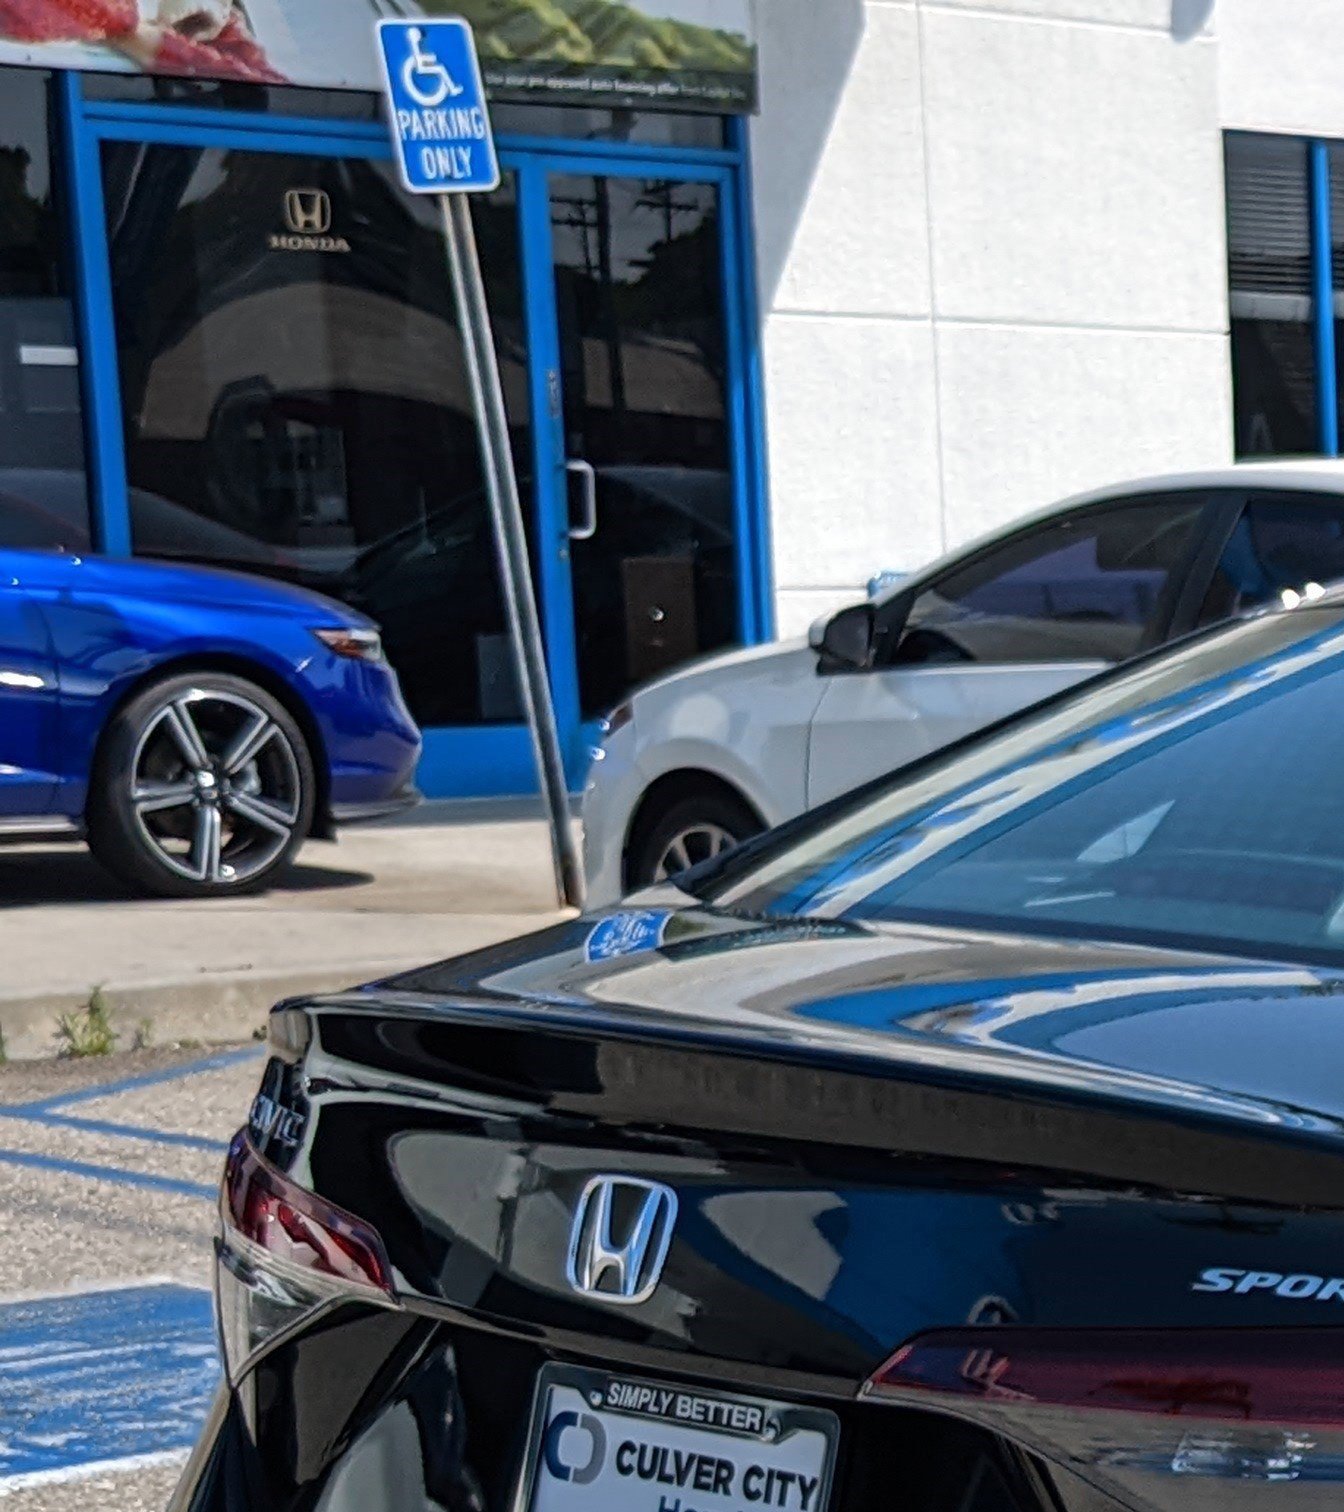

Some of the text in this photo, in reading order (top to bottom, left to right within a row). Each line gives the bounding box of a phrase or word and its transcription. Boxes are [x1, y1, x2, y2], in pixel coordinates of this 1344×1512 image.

[398, 107, 485, 140] PARKING
[421, 145, 473, 180] ONLY
[269, 234, 351, 252] HONDA
[606, 1382, 765, 1432] SIMPLY BETTER
[615, 1439, 820, 1512] CULVER CITY
